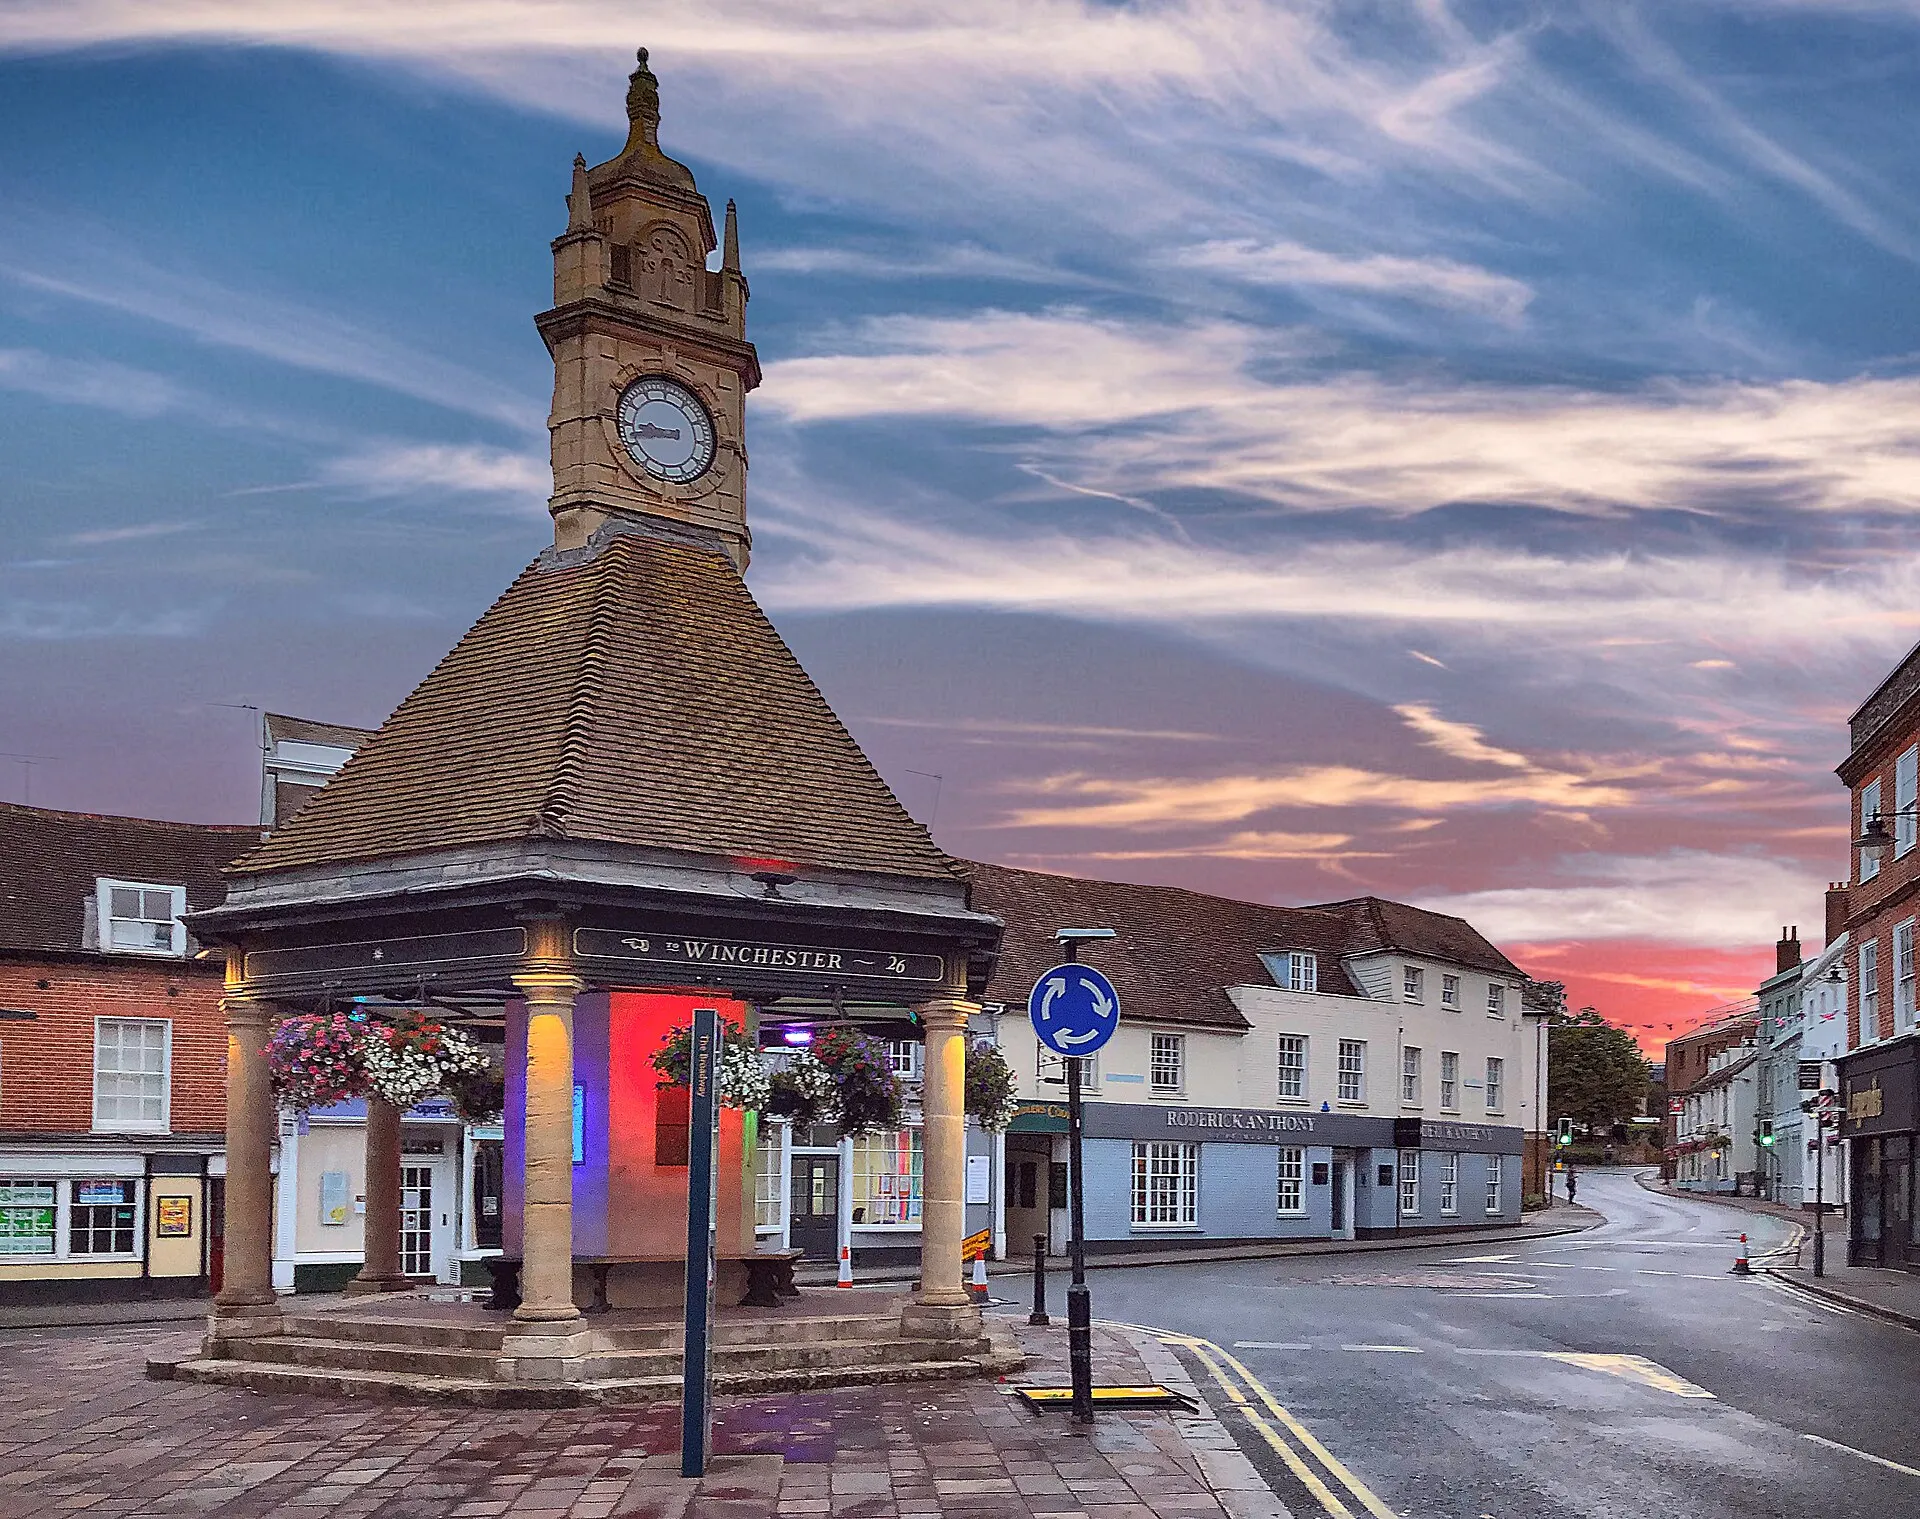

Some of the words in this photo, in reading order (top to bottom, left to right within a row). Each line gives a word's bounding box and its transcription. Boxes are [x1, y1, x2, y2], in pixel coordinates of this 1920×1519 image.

[684, 941, 842, 969] WINCHESTER
[885, 956, 906, 974] 26
[697, 1053, 709, 1097] Broadway
